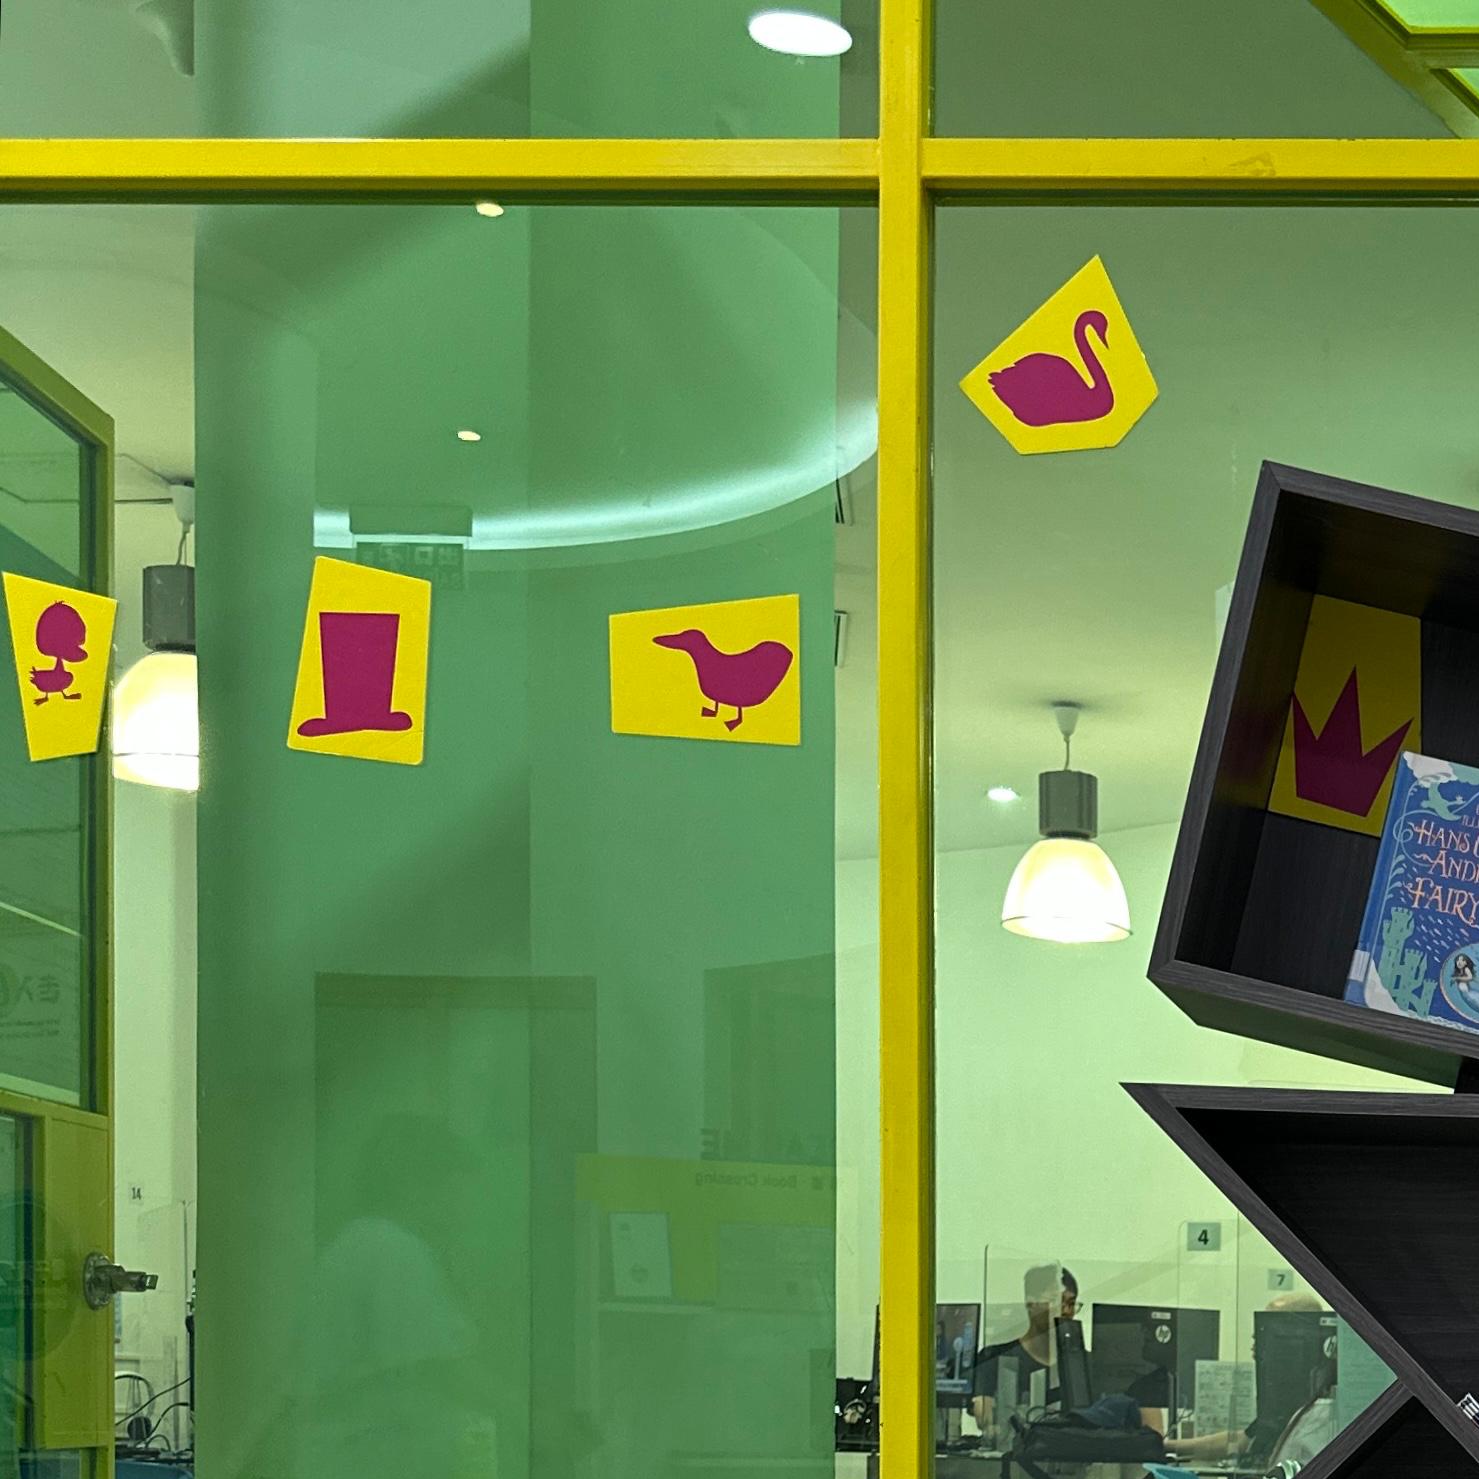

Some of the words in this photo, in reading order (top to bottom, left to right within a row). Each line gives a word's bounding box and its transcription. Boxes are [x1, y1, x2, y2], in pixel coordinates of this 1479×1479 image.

[1412, 819, 1470, 853] HANS
[1197, 1229, 1209, 1246] 4
[1276, 1274, 1286, 1287] 7
